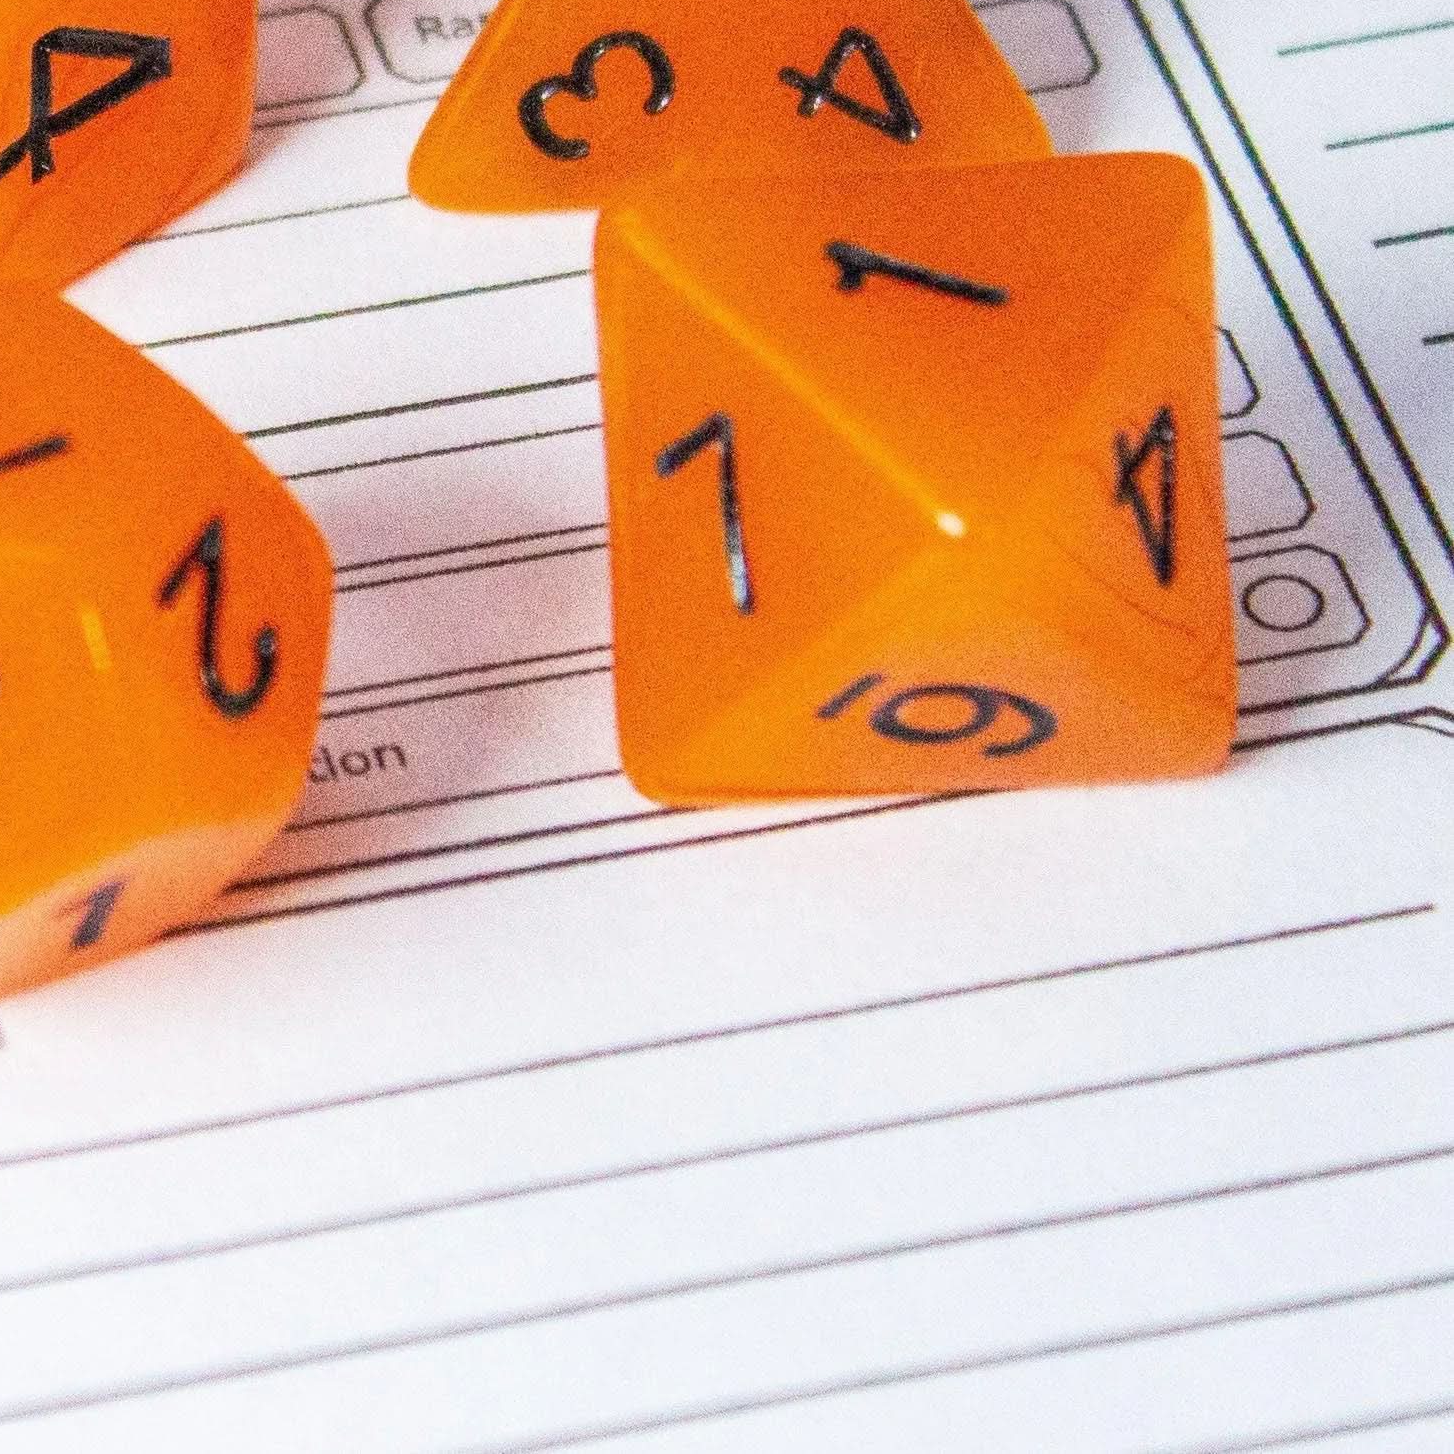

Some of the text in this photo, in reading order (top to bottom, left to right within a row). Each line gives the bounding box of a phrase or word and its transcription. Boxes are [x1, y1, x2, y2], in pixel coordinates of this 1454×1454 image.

[516, 29, 677, 162] 3
[777, 25, 924, 146] 4
[1113, 404, 1177, 588] 4
[157, 516, 280, 721] 2
